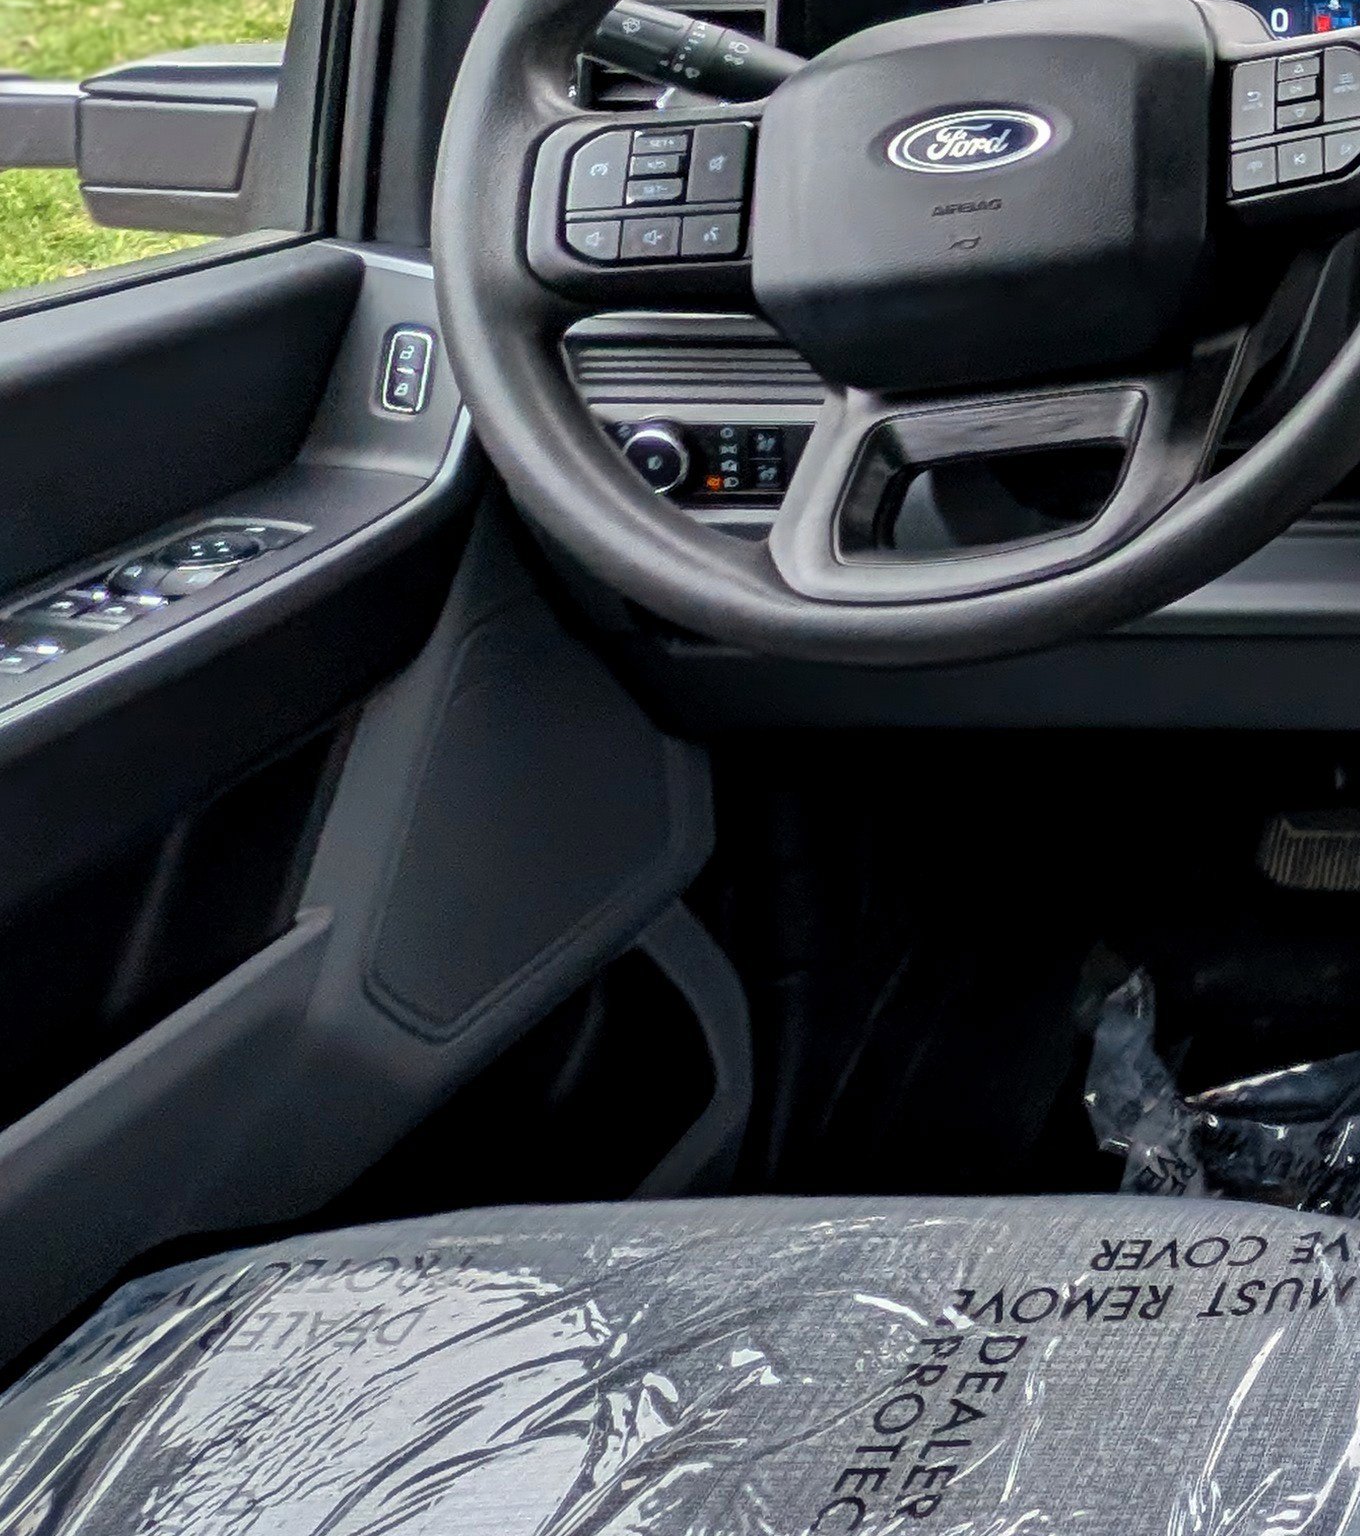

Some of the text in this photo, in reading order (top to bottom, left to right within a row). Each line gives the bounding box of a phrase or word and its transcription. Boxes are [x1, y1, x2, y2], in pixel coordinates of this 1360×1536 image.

[1270, 7, 1290, 33] 0
[926, 123, 1013, 161] Ford
[1089, 1234, 1269, 1272] COVER
[934, 1283, 1174, 1329] REMOVE
[1196, 1274, 1356, 1320] MUST
[884, 1335, 1028, 1523] DEALER
